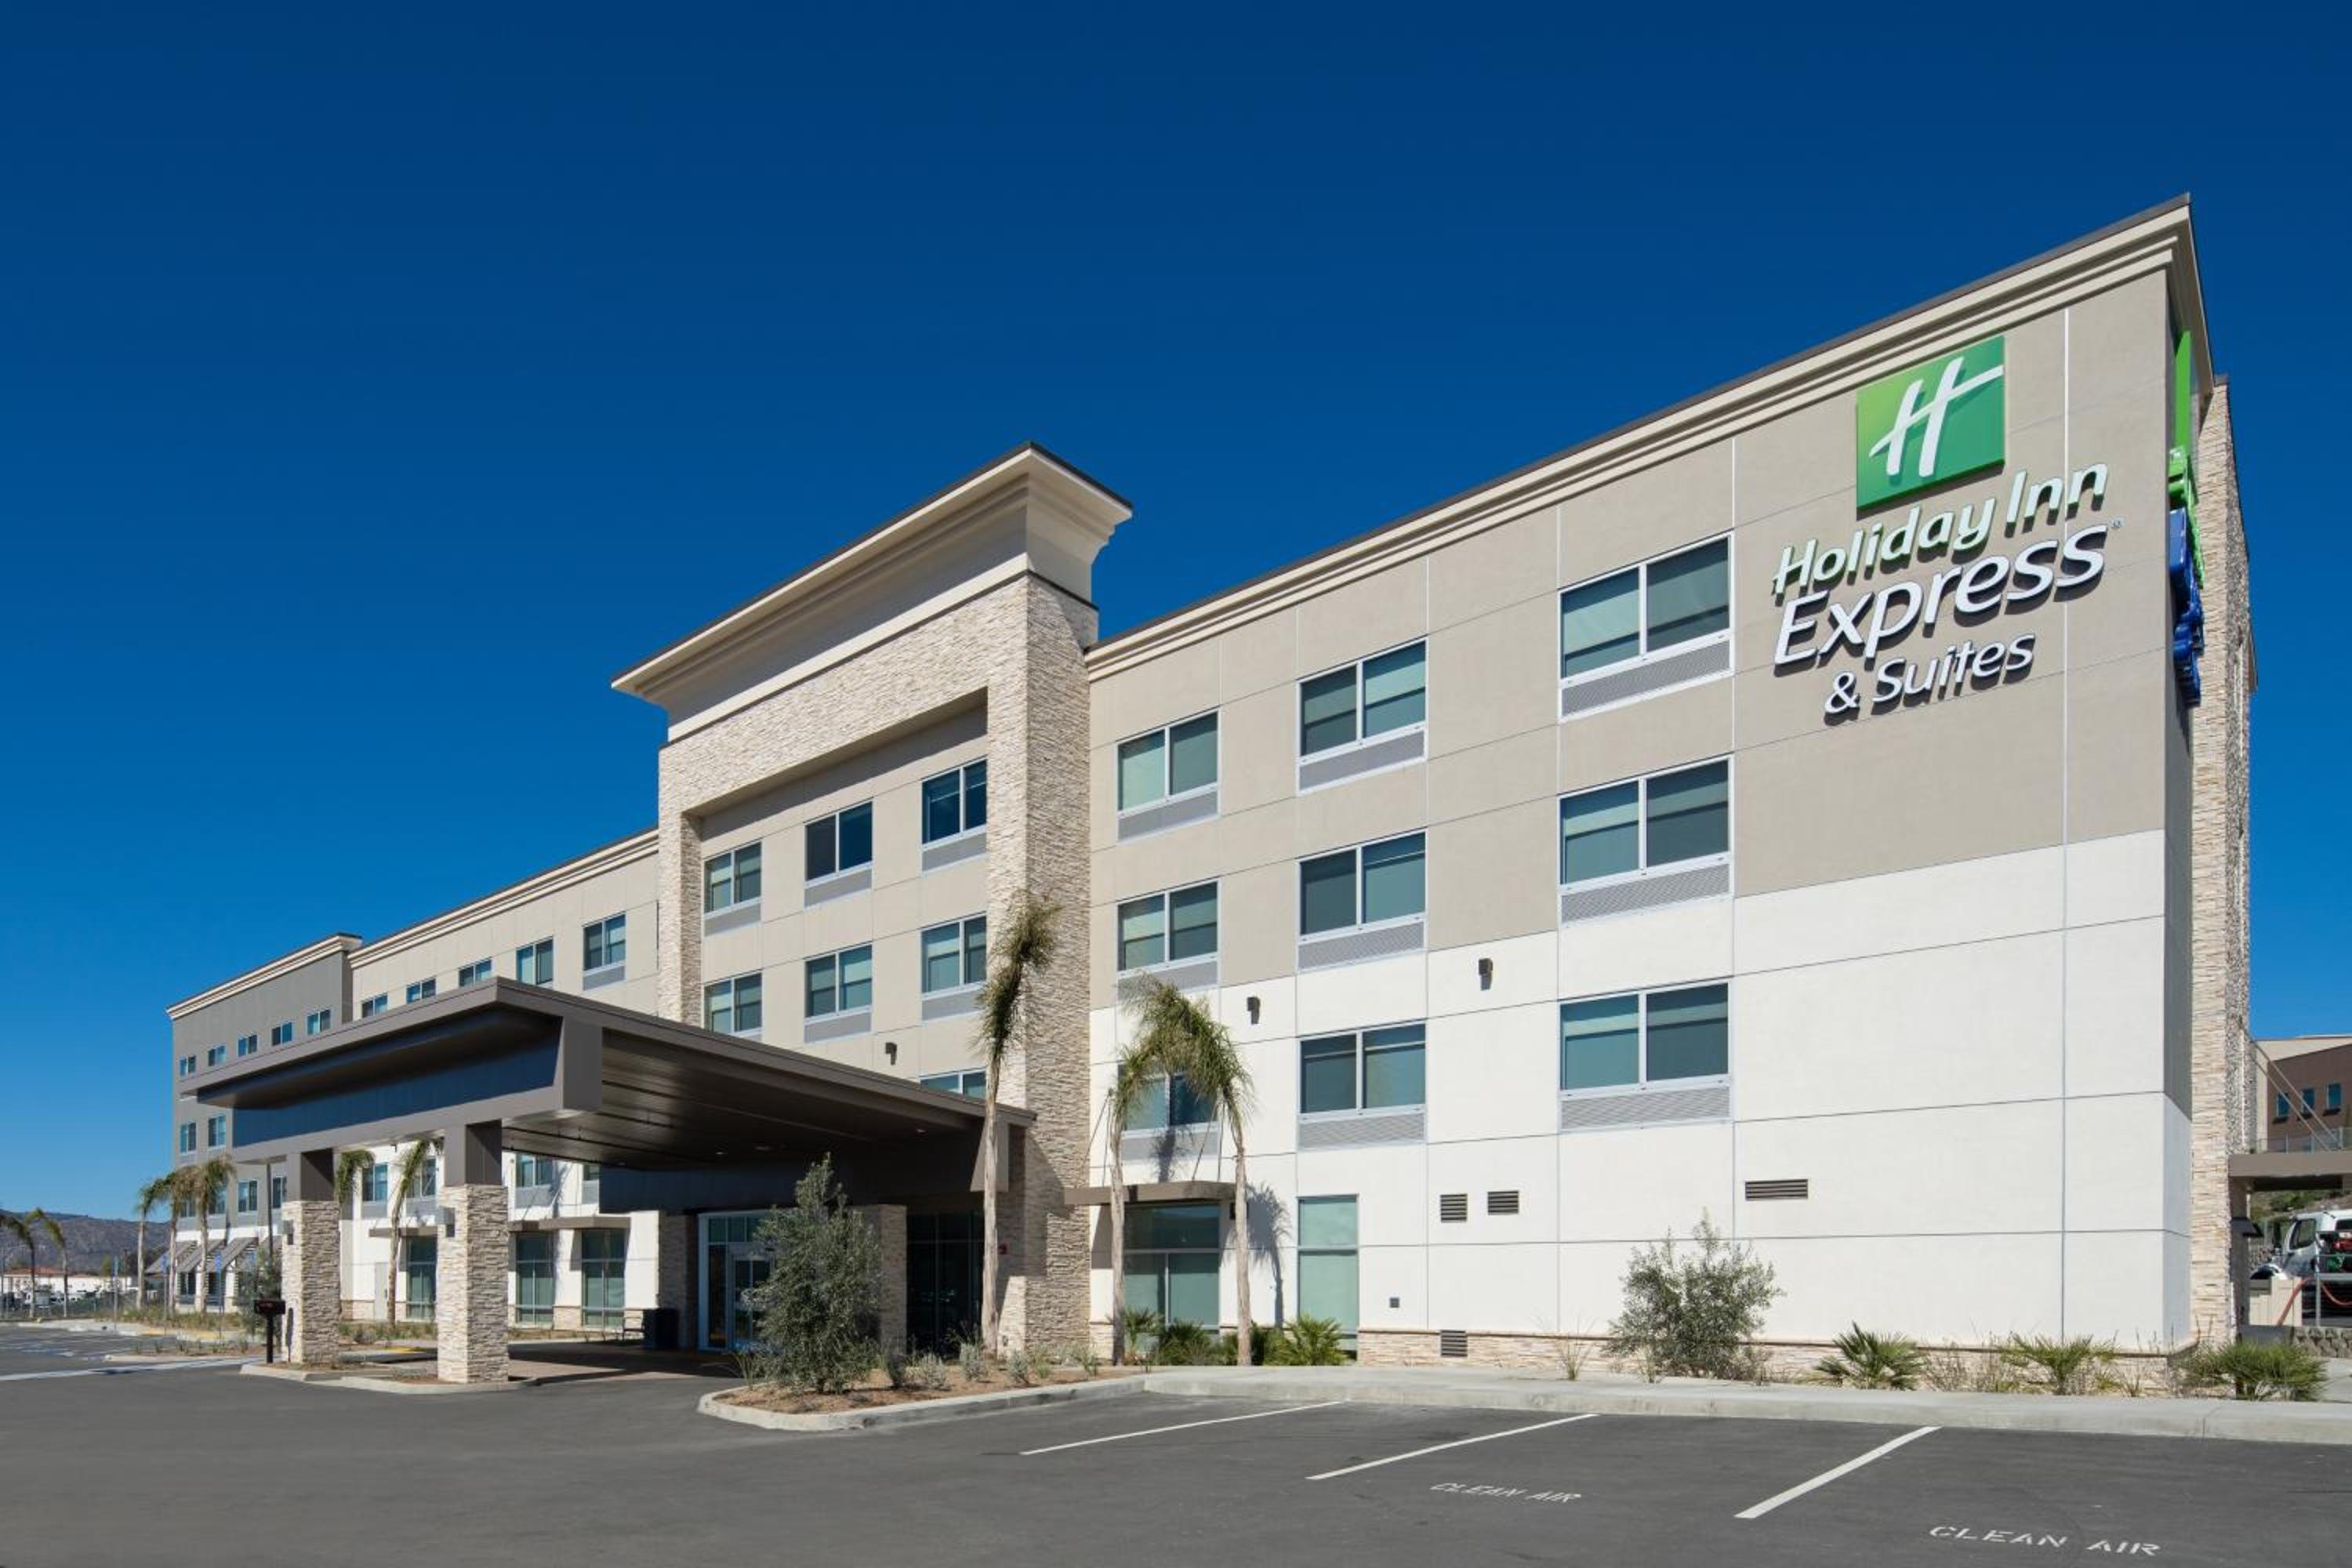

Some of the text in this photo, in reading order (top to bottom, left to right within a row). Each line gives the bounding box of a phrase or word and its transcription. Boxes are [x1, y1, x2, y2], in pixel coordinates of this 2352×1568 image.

[1868, 356, 2004, 478] H
[1772, 463, 2109, 594] Holiday Inn
[1774, 524, 2108, 666] Express
[1824, 633, 2036, 714] & Suites
[1429, 1482, 1582, 1503] CLEAN AIR
[1929, 1526, 2161, 1557] CLEAN AIR
